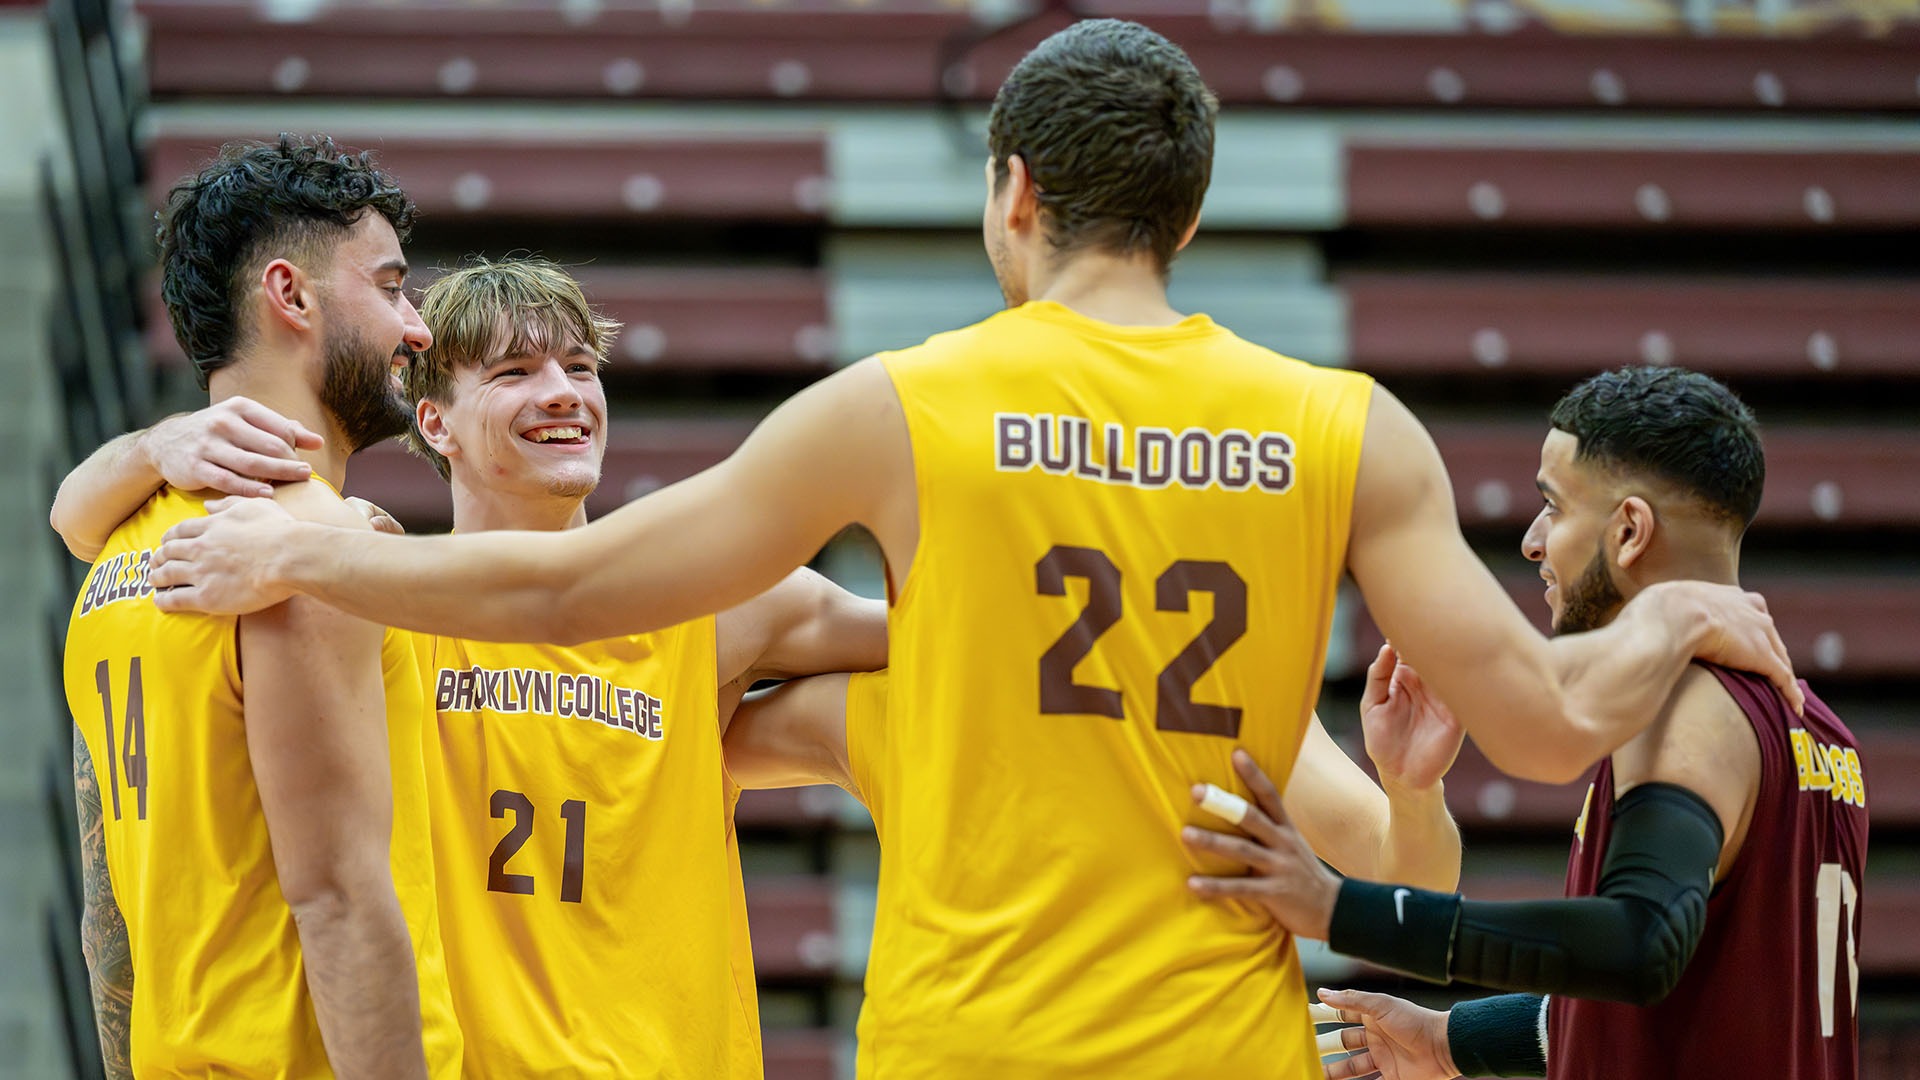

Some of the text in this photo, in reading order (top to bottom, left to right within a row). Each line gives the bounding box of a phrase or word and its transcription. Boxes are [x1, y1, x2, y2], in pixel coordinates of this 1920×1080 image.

[994, 412, 1296, 494] BULLDOGS
[1035, 544, 1248, 739] 22
[95, 656, 148, 821] 14
[556, 672, 664, 741] COLLEGE
[487, 789, 586, 903] 21
